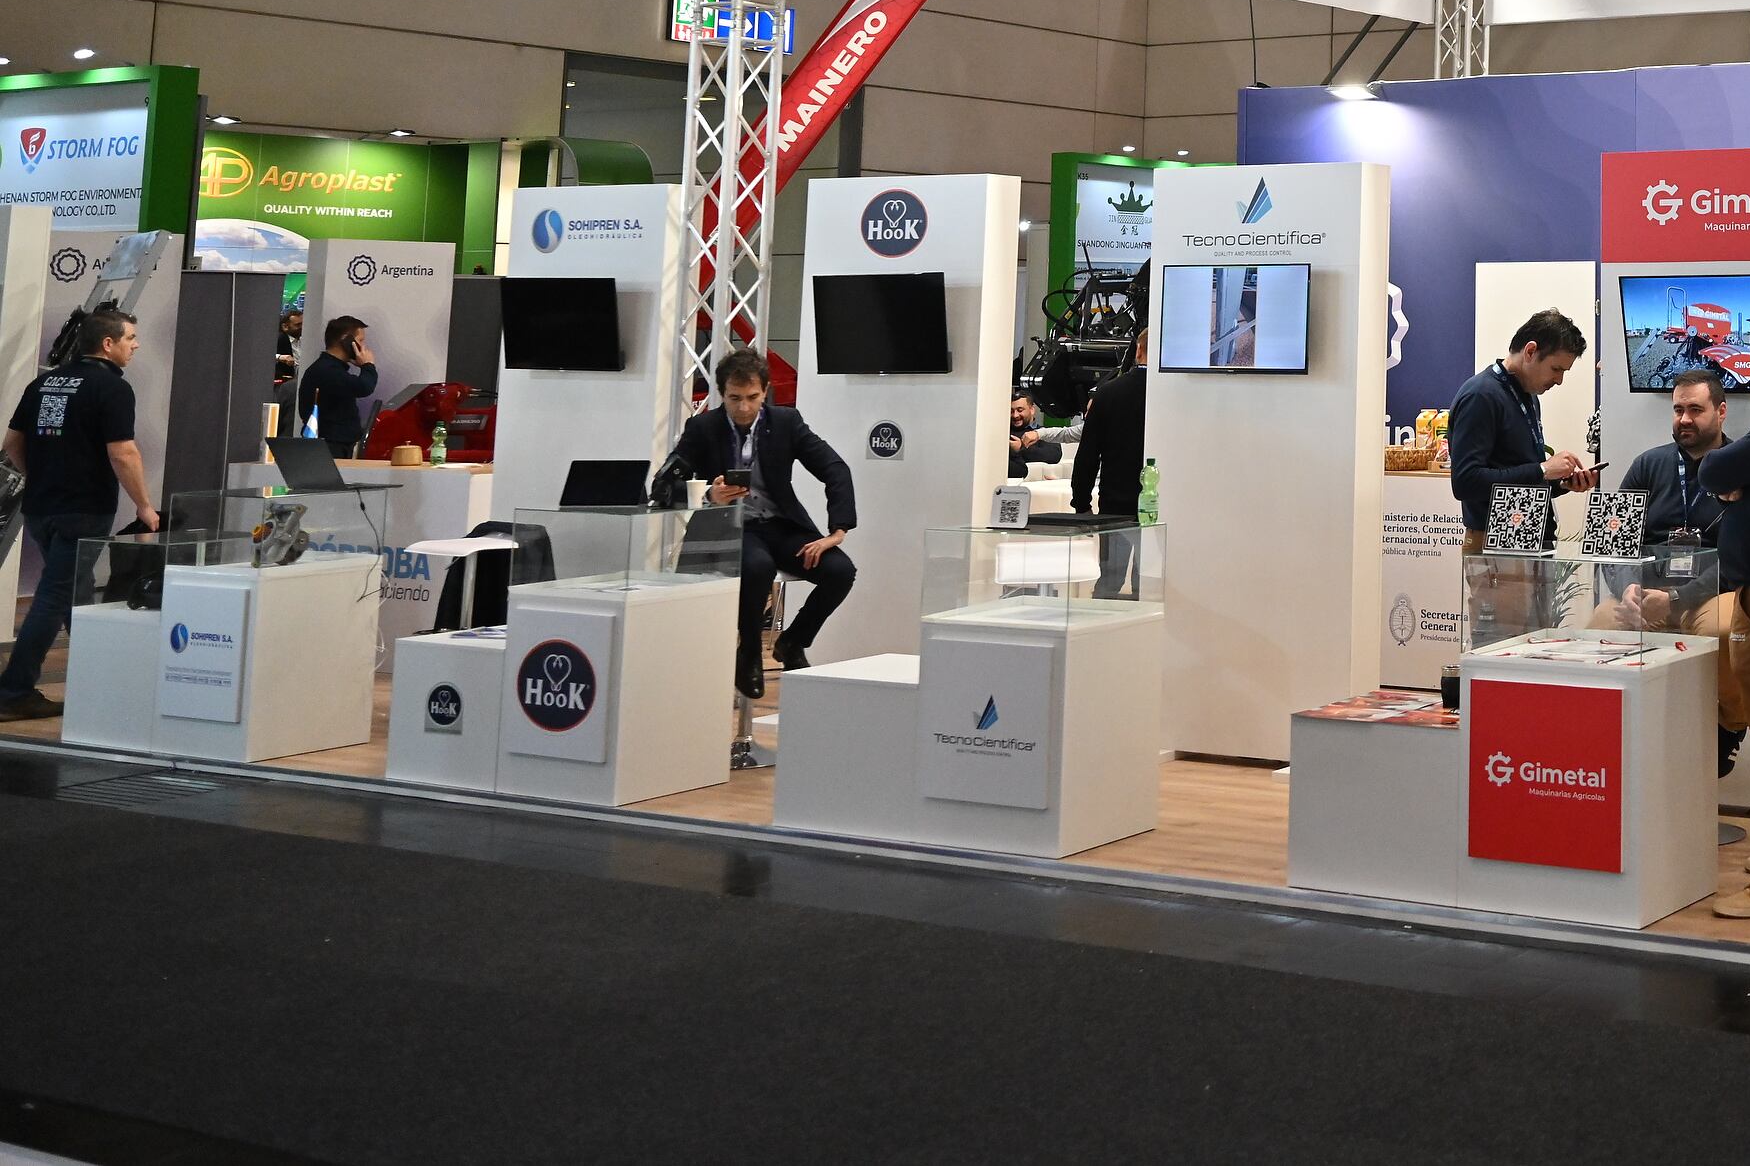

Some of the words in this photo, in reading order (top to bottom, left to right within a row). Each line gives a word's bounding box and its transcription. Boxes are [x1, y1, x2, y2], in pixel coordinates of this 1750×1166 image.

[777, 10, 887, 152] MAINERO
[47, 138, 103, 159] STORM
[107, 136, 139, 156] FOG
[259, 165, 399, 194] Agroplast
[0, 192, 28, 204] HENAN
[30, 191, 58, 203] STORM
[60, 190, 78, 201] FOG
[79, 188, 142, 201] ENVIRONMENT
[264, 204, 312, 215] QUALITY
[315, 206, 354, 217] WITHIN
[357, 208, 392, 218] REACH
[568, 220, 620, 231] SOHIPREN
[623, 219, 643, 230] S.A.
[1077, 239, 1115, 249] SHANDONG
[380, 264, 434, 280] Argentina
[1383, 513, 1418, 522] nisterio
[1420, 514, 1430, 522] de
[1432, 514, 1463, 524] Relacio
[1383, 524, 1420, 534] teriores,
[1422, 525, 1464, 535] Comercio
[1383, 536, 1431, 545] ternacional
[1432, 538, 1438, 547] y
[1440, 537, 1464, 546] Culto
[1407, 548, 1442, 558] Argentina
[380, 584, 430, 602] aciendo
[1420, 621, 1457, 632] General
[1420, 634, 1451, 642] Presidencia
[1520, 762, 1606, 788] Gimetal
[1529, 787, 1571, 799] Maquinarias
